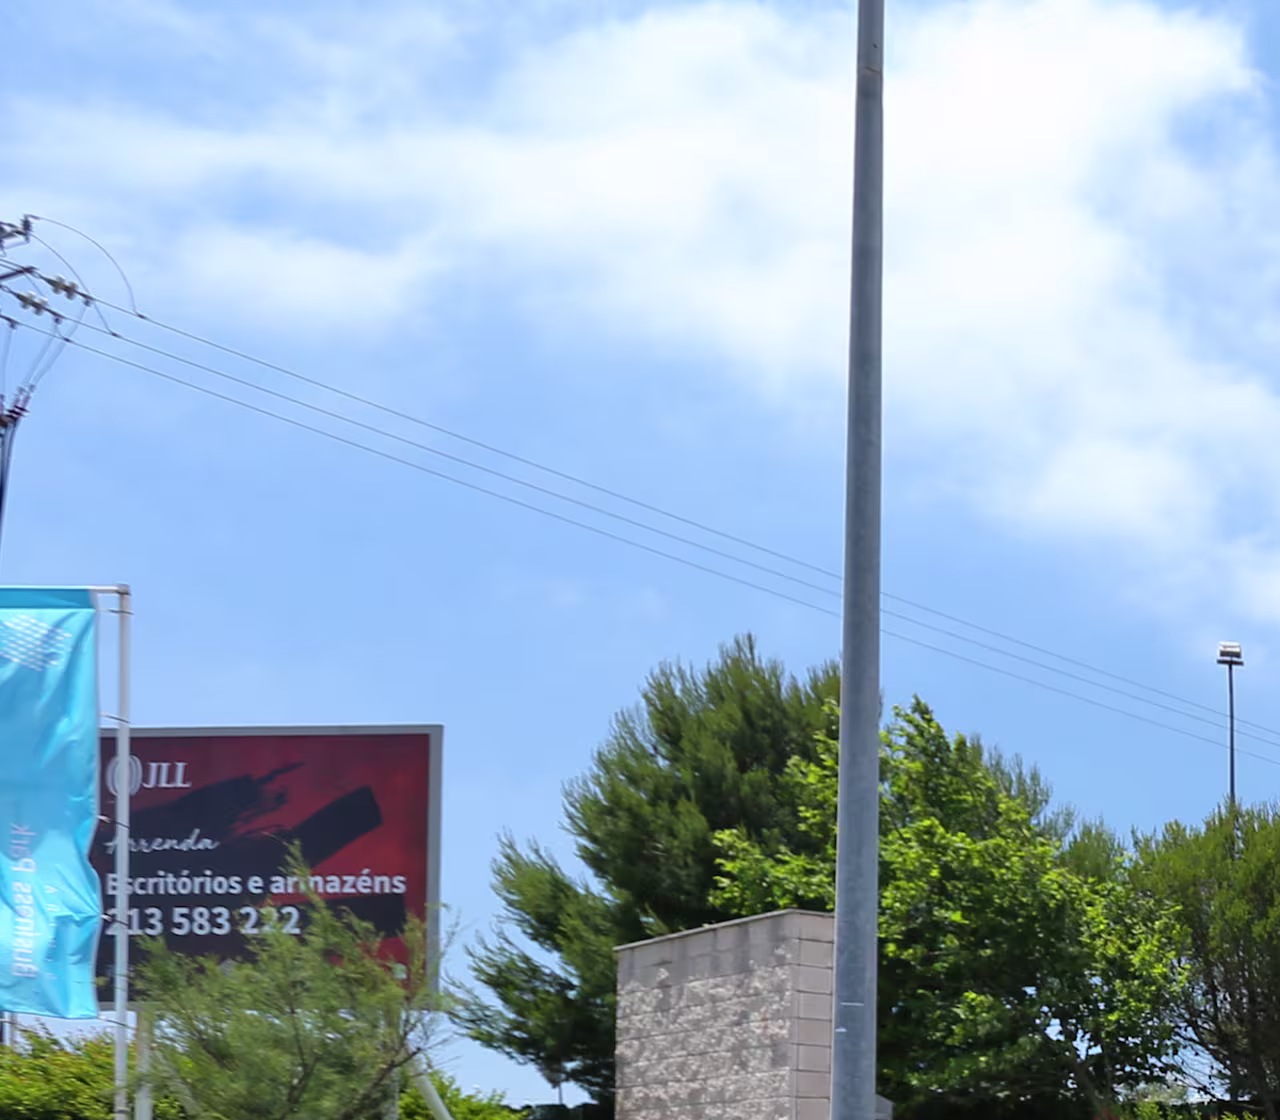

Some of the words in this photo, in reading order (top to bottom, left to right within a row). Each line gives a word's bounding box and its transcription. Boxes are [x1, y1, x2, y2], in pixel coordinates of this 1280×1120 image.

[142, 762, 192, 788] JLL
[248, 876, 264, 894] e
[270, 869, 406, 895] armazéns
[105, 907, 163, 935] 213
[172, 907, 230, 935] 583
